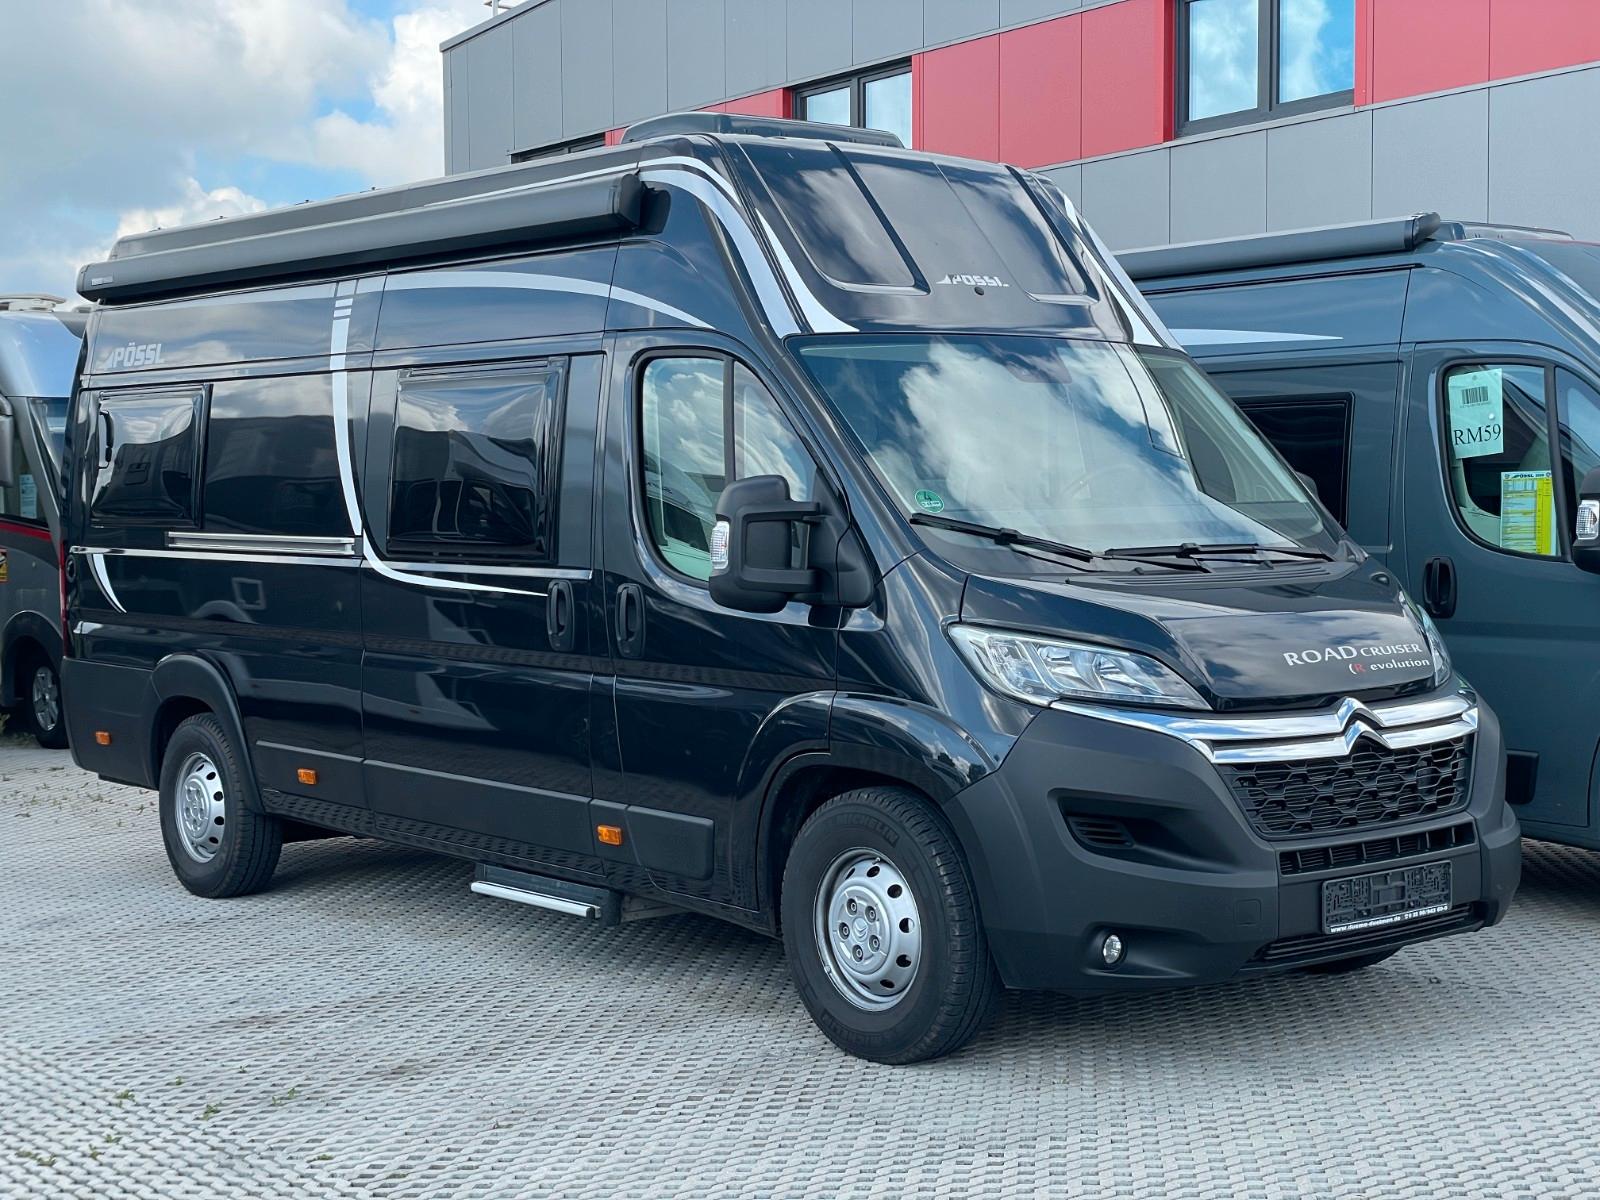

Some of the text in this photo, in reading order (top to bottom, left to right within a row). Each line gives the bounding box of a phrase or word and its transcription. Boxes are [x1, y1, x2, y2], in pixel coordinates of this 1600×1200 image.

[112, 342, 165, 368] PÖSSL
[1454, 423, 1502, 446] RM59
[1283, 643, 1423, 666] ROAD CRUISER
[1370, 658, 1430, 671] evolution
